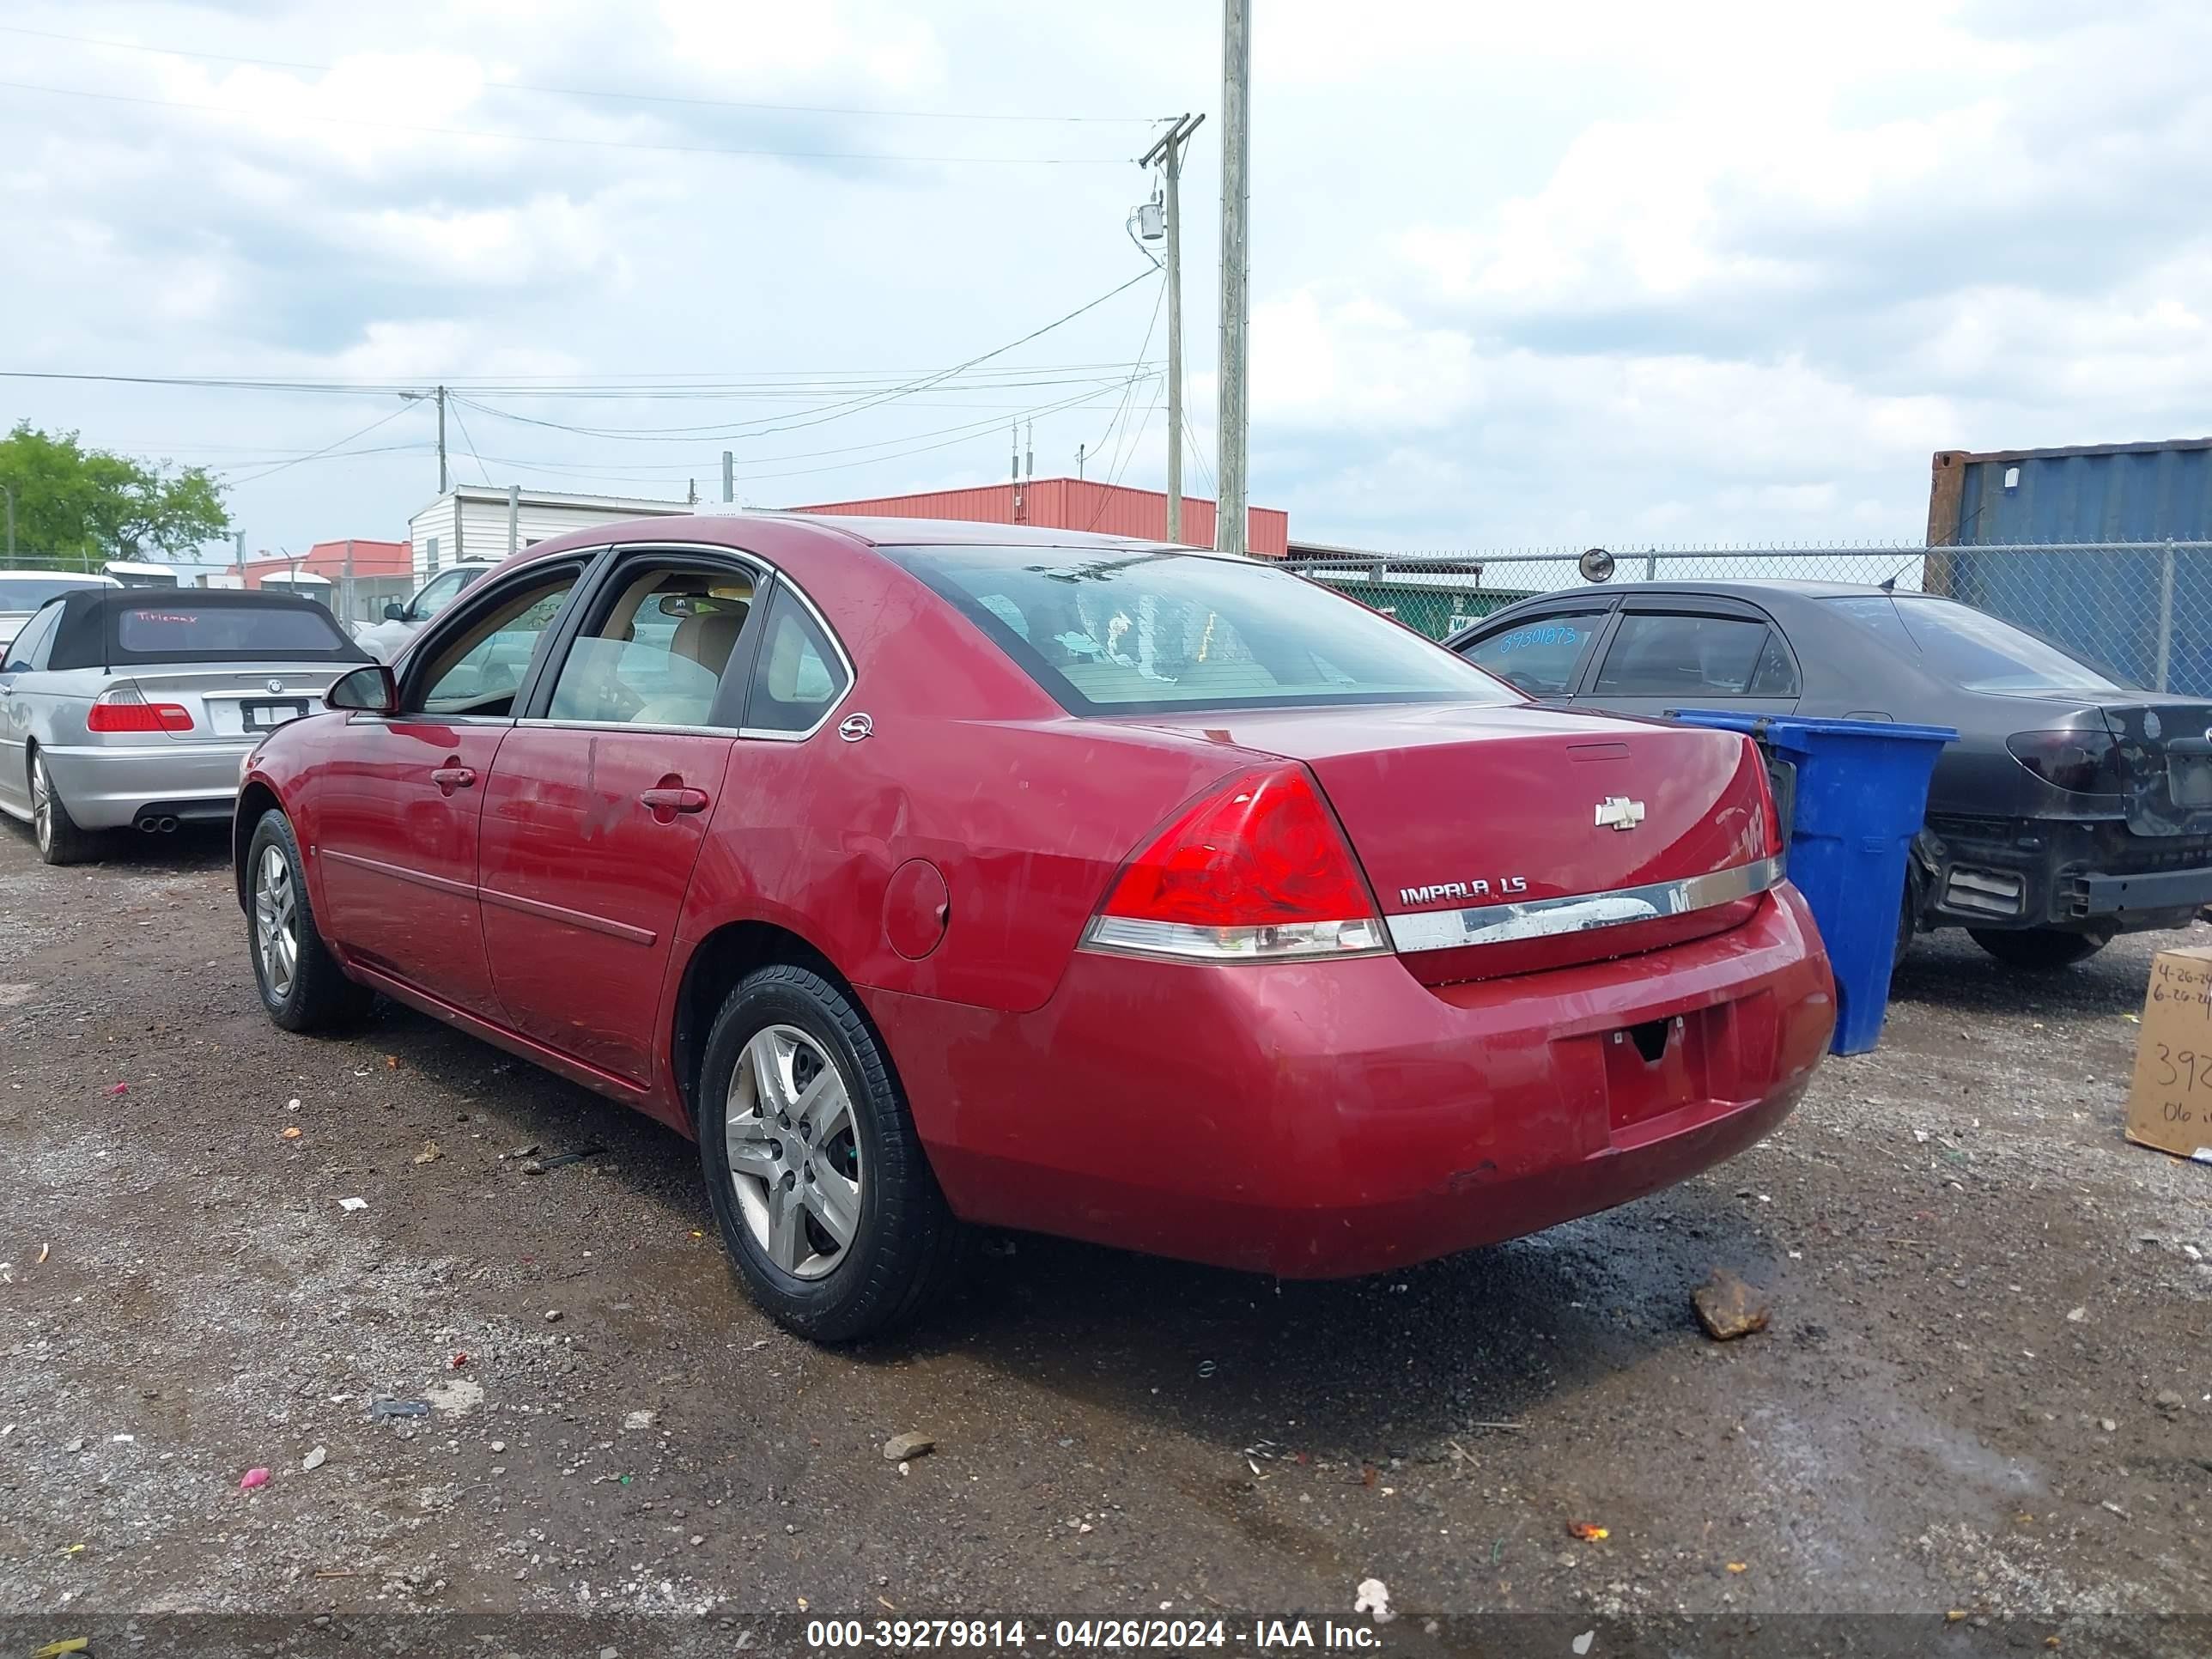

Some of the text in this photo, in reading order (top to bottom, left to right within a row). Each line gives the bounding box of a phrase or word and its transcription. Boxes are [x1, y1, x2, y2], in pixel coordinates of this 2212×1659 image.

[1500, 627, 1576, 653] 39301873
[1400, 877, 1527, 906] IMPALA LS
